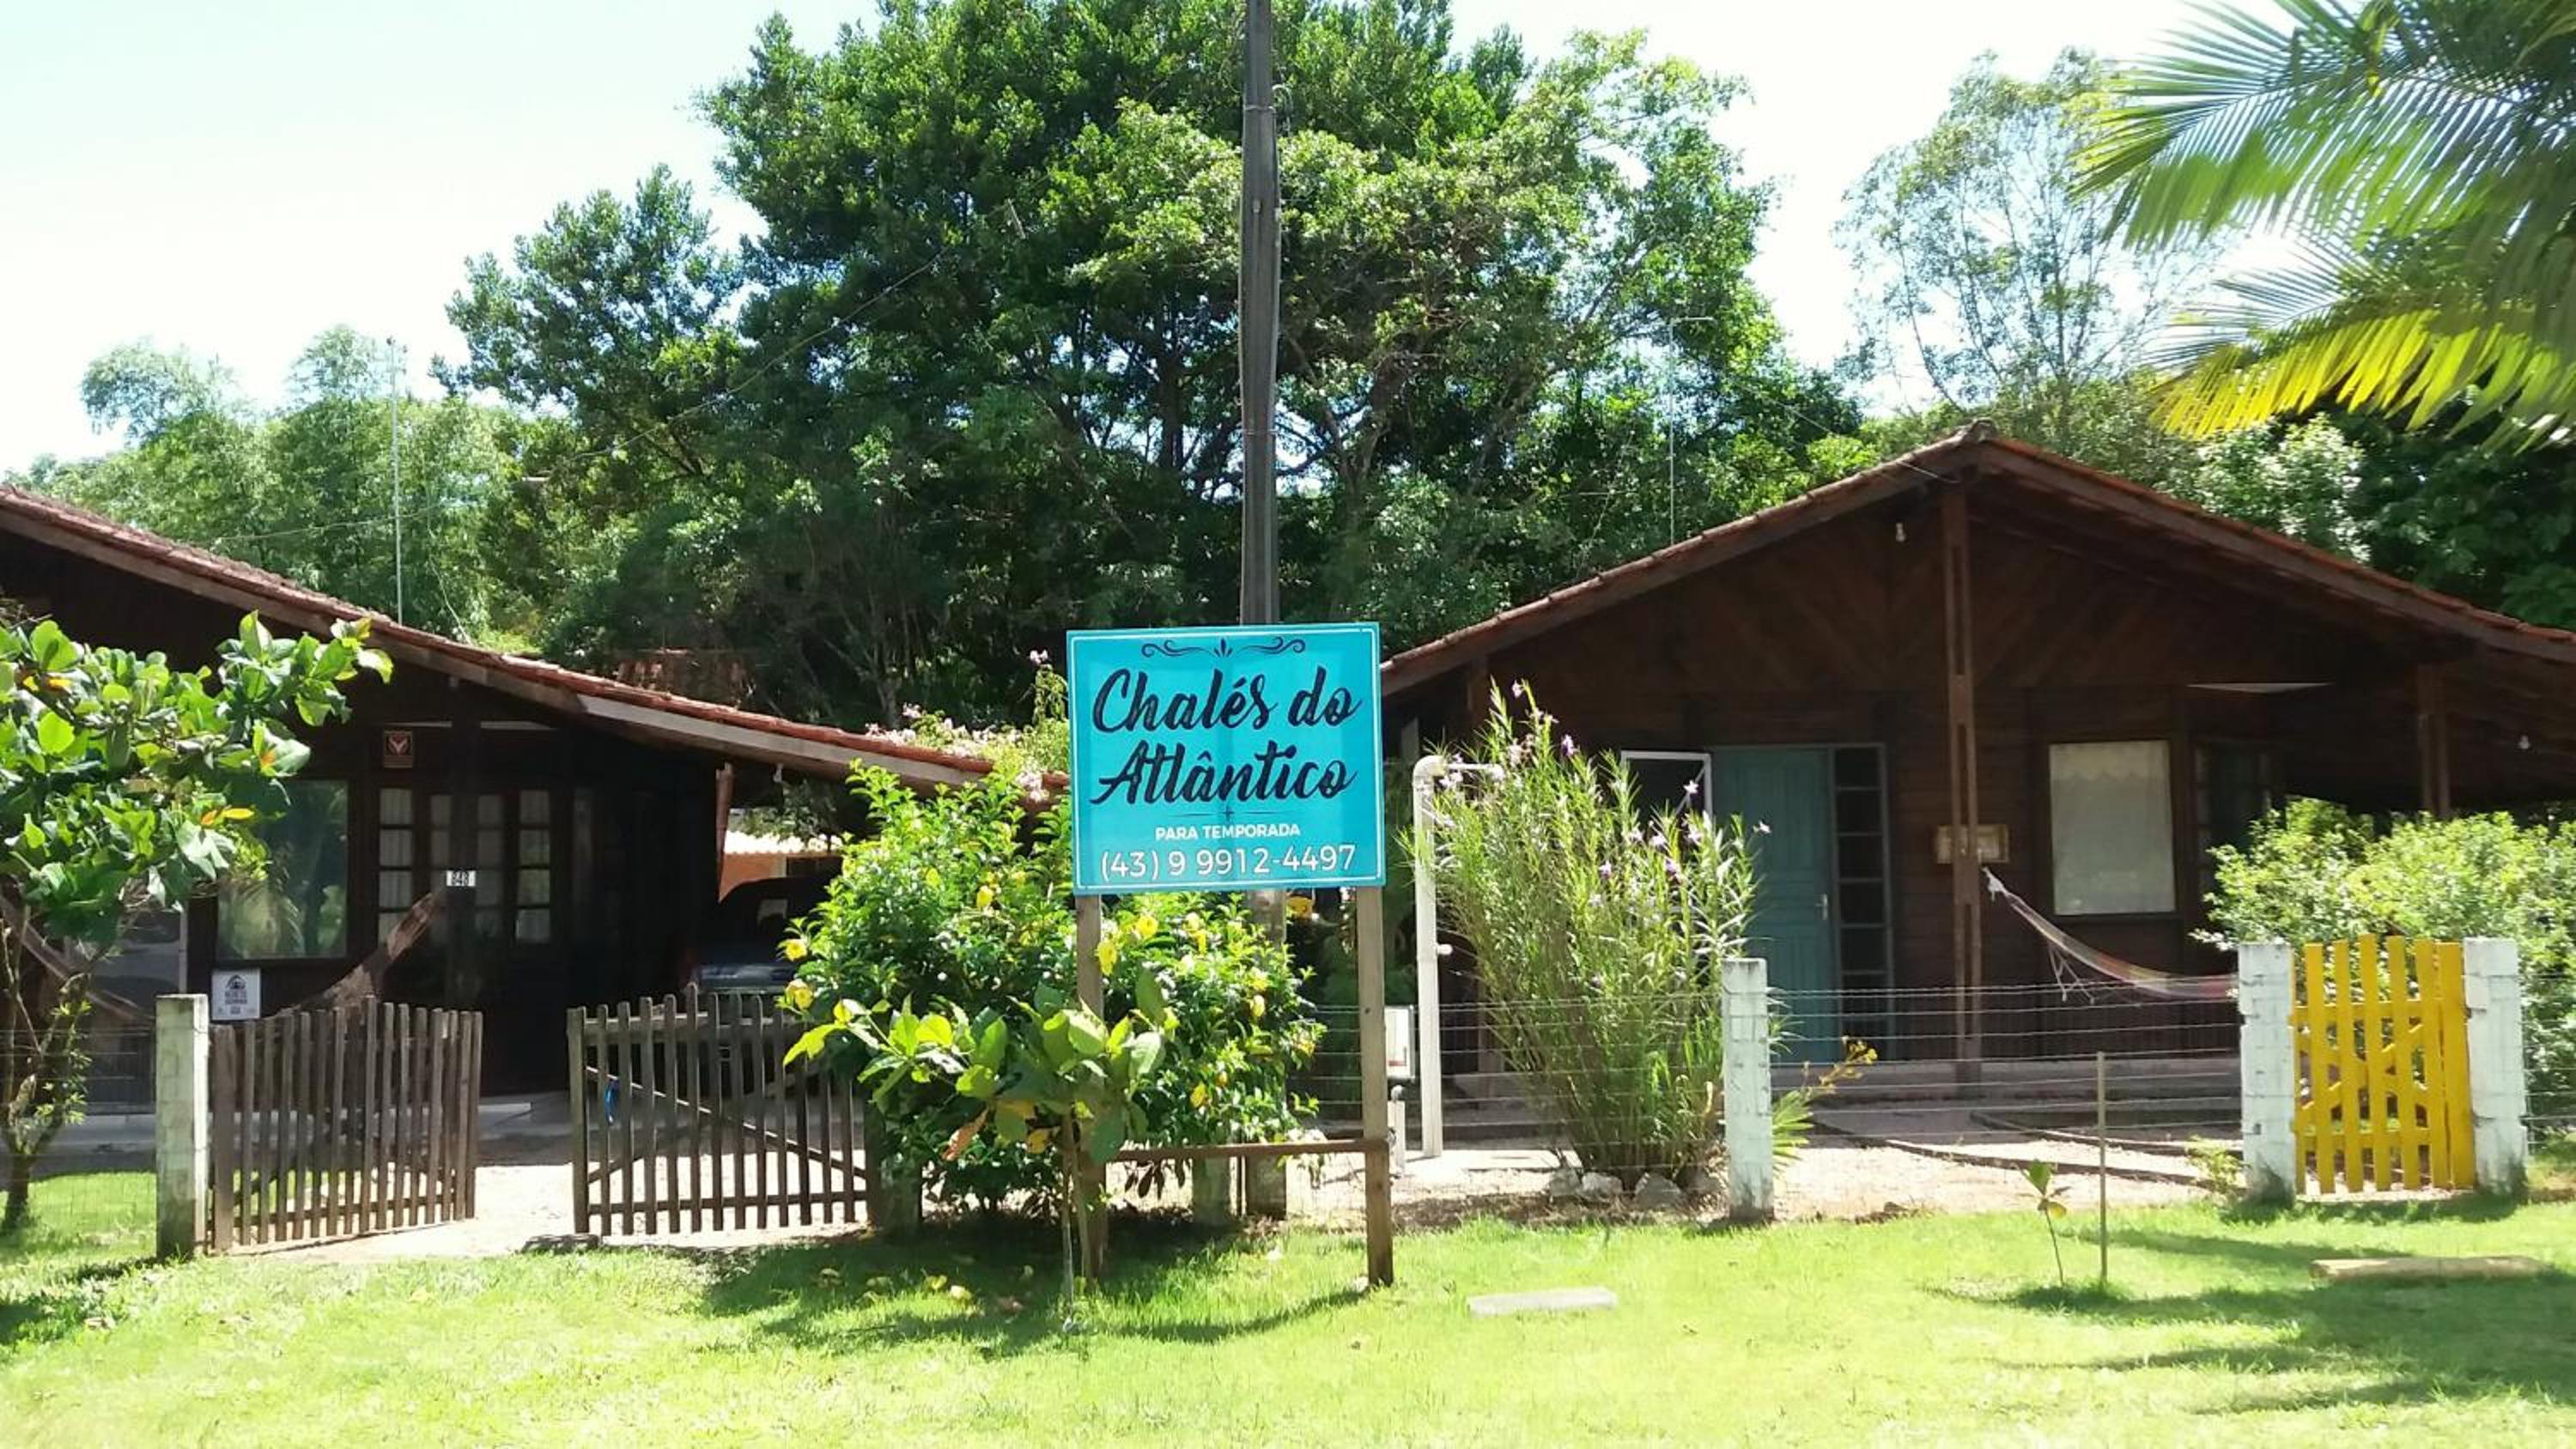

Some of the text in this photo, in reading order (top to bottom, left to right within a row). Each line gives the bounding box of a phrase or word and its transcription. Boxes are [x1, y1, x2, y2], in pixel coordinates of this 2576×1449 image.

[1093, 666, 1362, 732] Chalés do
[1090, 740, 1358, 804] Atlântico
[1155, 824, 1301, 840] PARA TEMPORADA
[1102, 845, 1357, 881] (43) 9 9912-4497
